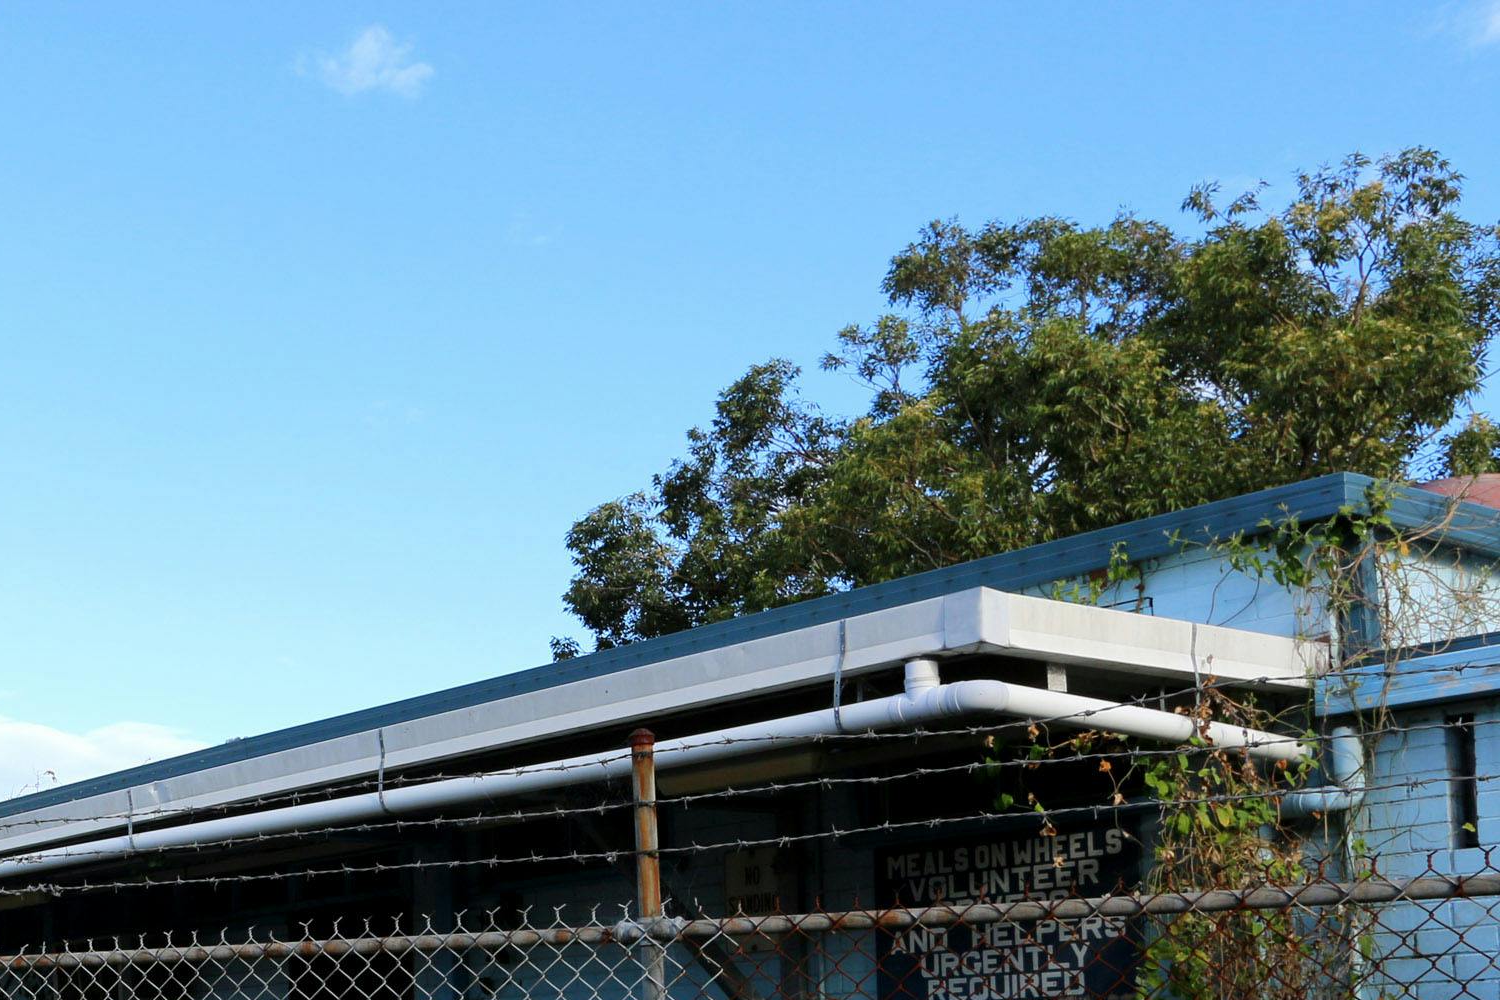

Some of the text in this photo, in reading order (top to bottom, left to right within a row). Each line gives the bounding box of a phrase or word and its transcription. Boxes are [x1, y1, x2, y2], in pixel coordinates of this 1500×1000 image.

[887, 828, 1123, 879] MEALS ON WHEELS
[744, 865, 760, 885] NO
[910, 859, 1100, 902] VOLUNTEER
[891, 915, 1126, 955] AND HELPERS
[921, 941, 1090, 978] URGENTLY
